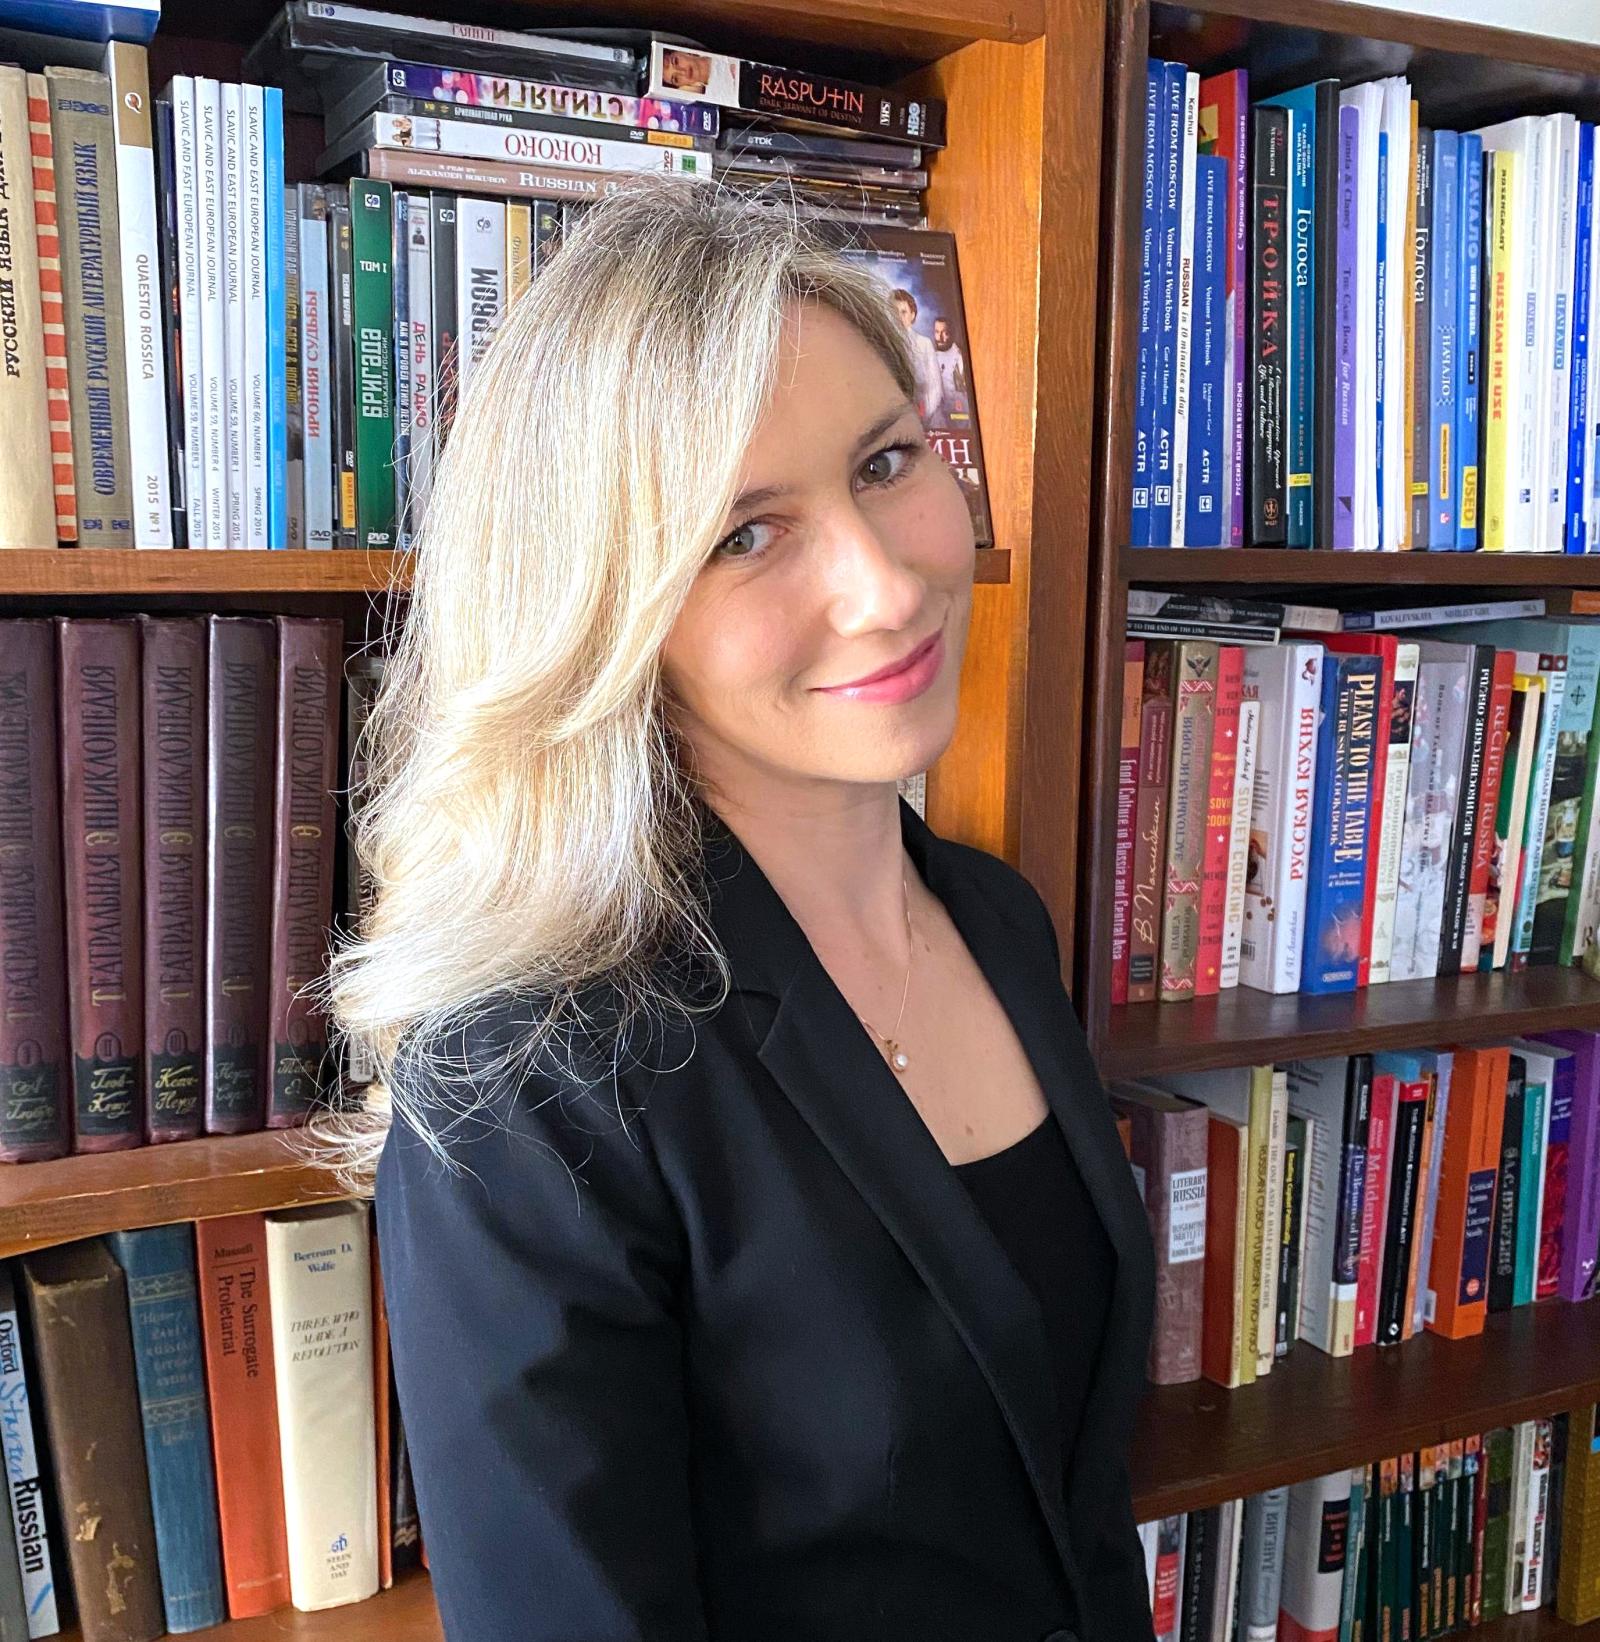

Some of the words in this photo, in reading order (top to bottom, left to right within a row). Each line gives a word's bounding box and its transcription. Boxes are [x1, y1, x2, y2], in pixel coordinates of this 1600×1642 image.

[492, 80, 624, 117] СТИЛЯГИ
[761, 73, 864, 114] RASPUTIN
[1171, 82, 1181, 107] LIVE
[204, 106, 213, 144] SLAVIC
[249, 106, 258, 144] SLAVIC
[907, 102, 920, 136] HBO
[1169, 111, 1180, 147] FROM
[1187, 98, 1195, 136] Kershul
[205, 148, 213, 168] AND
[250, 148, 258, 168] AND
[505, 134, 602, 165] КОКОКО
[754, 136, 772, 146] TDK
[73, 142, 97, 188] ЯЗЫК
[206, 170, 214, 193] EAST
[250, 170, 258, 193] EAST
[1167, 151, 1178, 210] MOSCOW
[206, 195, 215, 250] EUROPEAN
[250, 195, 259, 250] EUROPEAN
[1467, 160, 1481, 259] НАЧАЛО
[1499, 169, 1507, 251] ROSENGRANT
[75, 191, 105, 311] ЛИТЕРАТУРНЫЙ
[360, 260, 380, 273] ТОМ
[383, 261, 387, 273] I
[1166, 228, 1175, 267] Volume
[1296, 207, 1312, 287] Голоса
[1415, 228, 1429, 303] Голоса
[135, 254, 154, 319] QUAESTIO
[207, 254, 216, 301] JOURNAL
[251, 253, 260, 300] JOURNAL
[1181, 258, 1190, 306] RUSSIAN
[1342, 268, 1350, 291] THE
[1164, 277, 1173, 332] Workbook
[1181, 311, 1188, 324] in
[1495, 272, 1505, 354] RUSSIAN
[1526, 294, 1536, 345] НАЧАЛО
[304, 291, 319, 361] СУДЬБЫ
[412, 322, 426, 363] ДЕНЬ
[1180, 327, 1188, 338] 10
[1342, 325, 1351, 356] BOOK
[1554, 294, 1566, 368] НАЧАЛО
[80, 315, 108, 381] РУССКИЙ
[140, 325, 156, 380] ROSSICA
[1179, 342, 1188, 384] minutes
[1204, 327, 1212, 366] Textbook
[1441, 335, 1451, 396] НАЧАЛО
[361, 328, 383, 418] БРИГАДА
[1342, 360, 1350, 379] for
[1494, 361, 1503, 378] IN
[210, 377, 218, 411] VOLUME
[306, 367, 320, 438] ИРОНИЯ
[415, 373, 427, 427] РАДИО
[1177, 396, 1186, 415] day
[1341, 382, 1350, 425] Russian
[1493, 384, 1502, 420] USE
[84, 386, 116, 496] СОВРЕМЕННЫЙ
[211, 431, 219, 463] NUMBER
[253, 429, 261, 460] NUMBER
[1202, 449, 1210, 484] ACTR
[146, 475, 161, 504] 2015
[212, 488, 220, 516] WINTER
[1464, 472, 1476, 522] USED
[213, 518, 221, 540] 2015
[254, 517, 262, 536] 2016
[367, 532, 390, 543] DVD
[1339, 691, 1348, 716] THE
[1347, 674, 1376, 740] PLEASE
[1550, 704, 1561, 736] FOOD
[157, 664, 194, 846] ЭНЦИКЛОПЕДИЯ
[290, 665, 328, 841] ЭНЦИКЛОПЕДИЯ
[1180, 717, 1193, 775] ИСТОРИЯ
[1296, 708, 1315, 780] КУХНЯ
[1335, 718, 1347, 772] RUSSIAN
[1349, 746, 1370, 766] TO
[1463, 719, 1485, 836] ВЕЛИКОСВЕТСКИЕ
[1476, 668, 1490, 715] ОБЕДЫ
[1487, 705, 1506, 787] RECIPES
[1119, 759, 1137, 784] Food
[1347, 770, 1368, 808] THE
[1544, 753, 1554, 796] RUSSIAN
[1117, 788, 1135, 824] Culture
[1175, 777, 1190, 861] ЗАСТОЛЬНАЯ
[1234, 787, 1250, 846] SOVIET
[1330, 774, 1343, 845] COOKBOOK
[1538, 799, 1549, 844] HISTORY
[1116, 828, 1132, 838] in
[1290, 788, 1309, 880] РУССКАЯ
[1334, 808, 1365, 862] TABLE
[1475, 803, 1496, 868] RUSSIA
[1115, 842, 1132, 875] Russia
[1533, 846, 1542, 868] AND
[1114, 878, 1130, 896] and
[1229, 850, 1245, 923] COOKING
[1526, 871, 1540, 918] CULTURE
[159, 852, 194, 1006] ТЕАТРАЛЬНАЯ
[1113, 900, 1128, 936] Central
[1112, 940, 1126, 960] Asia
[1353, 1154, 1364, 1171] The
[1408, 1125, 1417, 1161] RUSSIAN
[1172, 1175, 1206, 1190] LITERARY
[1173, 1186, 1206, 1203] RUSSIA
[1349, 1175, 1363, 1220] Returns
[1402, 1164, 1413, 1215] EXPERIMENT
[1470, 1180, 1493, 1192] Critical
[1360, 1154, 1381, 1265] Maidenhair
[293, 1248, 337, 1263] Bertram
[341, 1242, 353, 1254] D.
[1265, 1220, 1274, 1269] HALF-EYED
[1399, 1227, 1407, 1245] ART
[238, 1267, 255, 1297] The
[307, 1261, 335, 1274] Wolfe
[1263, 1272, 1271, 1309] ARCHER
[217, 1275, 236, 1357] Proletariat
[290, 1314, 324, 1334] THREE
[329, 1310, 361, 1326] WHO
[300, 1329, 335, 1345] MADE
[338, 1326, 348, 1339] A
[240, 1303, 258, 1378] Surrogate
[291, 1339, 361, 1363] REVOLUTION
[1, 1319, 19, 1375] Oxford
[14, 1478, 44, 1573] Russian
[1262, 1511, 1279, 1573] ДАНЕЛИЯ
[329, 1562, 350, 1572] AND
